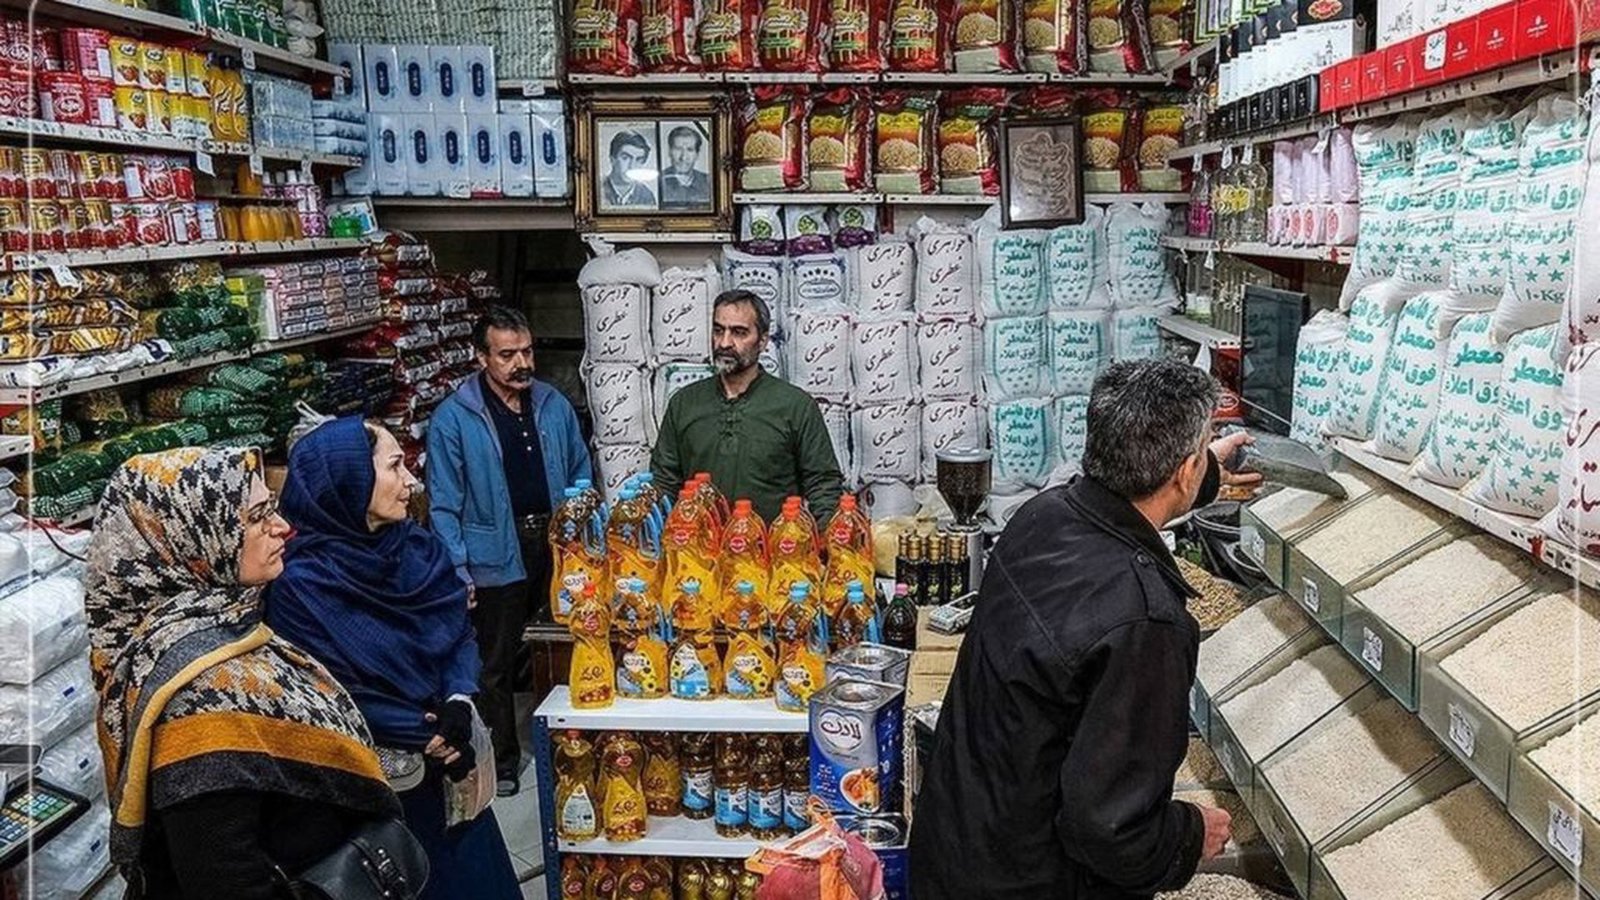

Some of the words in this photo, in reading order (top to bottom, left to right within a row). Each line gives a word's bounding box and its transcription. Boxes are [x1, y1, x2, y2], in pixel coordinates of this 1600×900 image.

[1529, 146, 1584, 177] معطر
[1397, 326, 1436, 351] معطر
[1349, 354, 1374, 376] فوق
[1453, 342, 1504, 367] معطر
[1298, 371, 1327, 388] معطر
[1405, 362, 1437, 386] فوق
[1509, 357, 1565, 387] معطر
[1308, 396, 1332, 417] فوق
[820, 718, 862, 741] لادن
